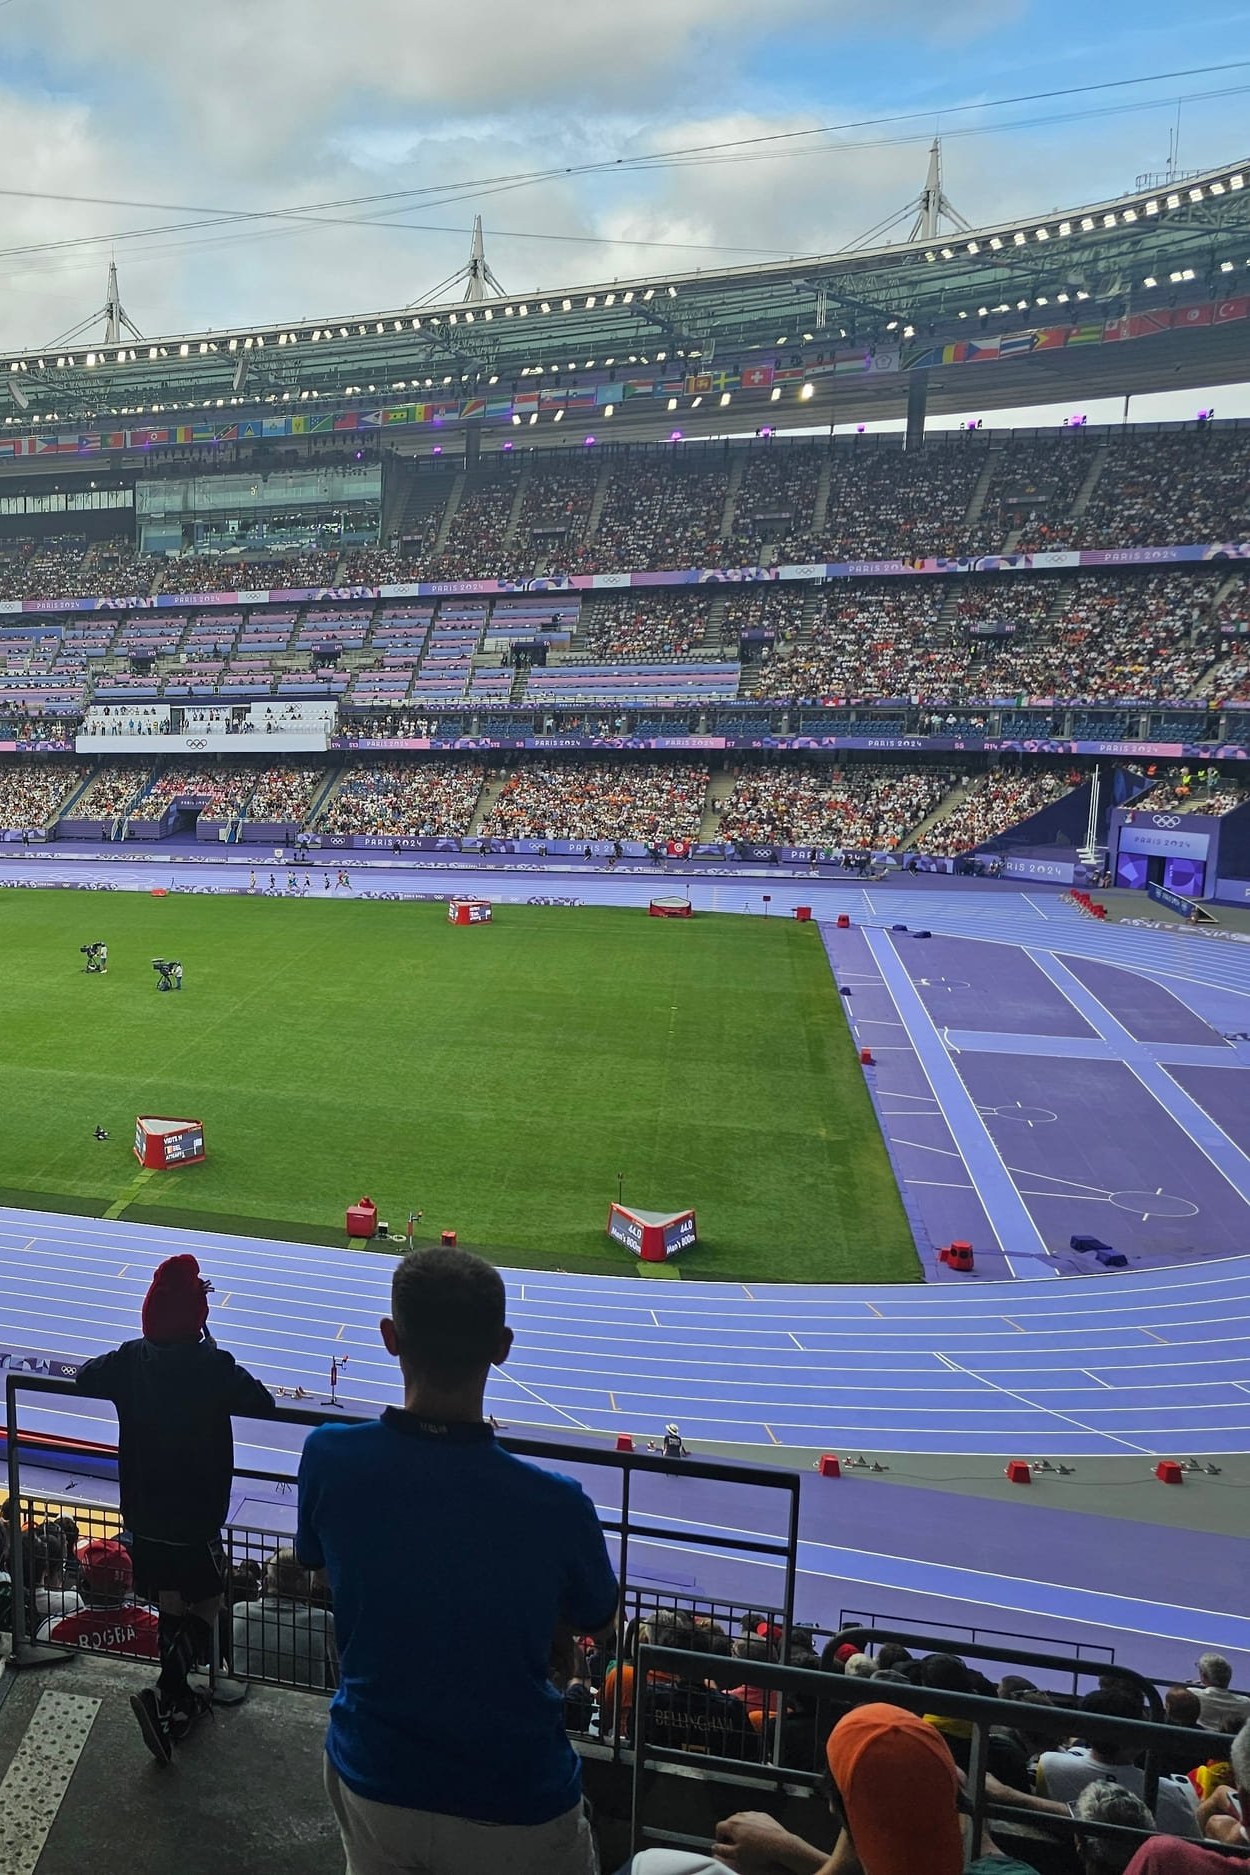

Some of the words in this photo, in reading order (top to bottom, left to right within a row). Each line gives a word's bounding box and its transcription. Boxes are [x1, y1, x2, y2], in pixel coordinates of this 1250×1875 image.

[1144, 551, 1177, 559] 2024
[1134, 836, 1161, 845] PARIS
[1164, 840, 1190, 848] 2024
[1006, 862, 1025, 871] RIS
[1030, 863, 1061, 875] 2024
[628, 1224, 642, 1239] 44.0
[680, 1219, 693, 1233] 44.0
[611, 1226, 626, 1242] Men's
[627, 1237, 642, 1253] 800m
[666, 1240, 681, 1254] Men's
[681, 1235, 695, 1246] 800m
